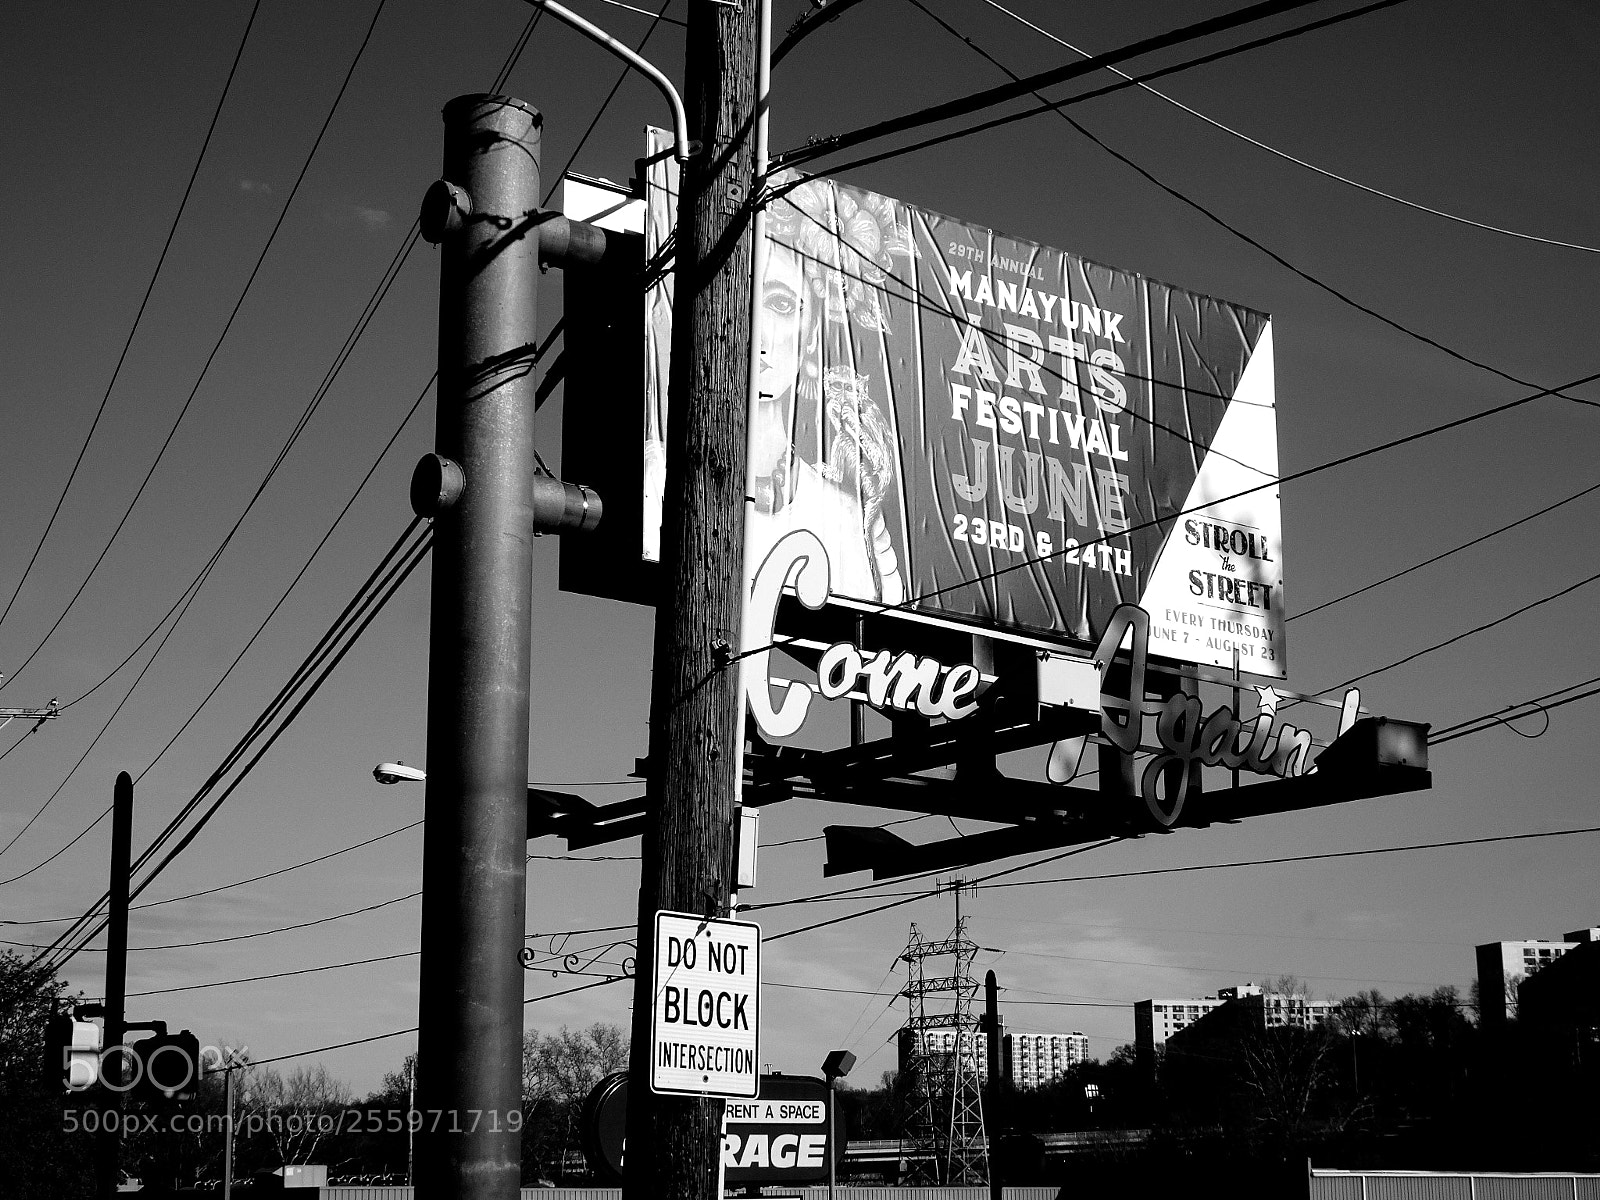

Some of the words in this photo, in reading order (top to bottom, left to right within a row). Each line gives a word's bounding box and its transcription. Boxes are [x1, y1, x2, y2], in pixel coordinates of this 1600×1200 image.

[949, 242, 985, 263] 29TH
[991, 253, 1045, 281] ANNUAL
[949, 265, 1126, 343] MANAYUNK
[951, 313, 1127, 413] ARTS
[951, 383, 1129, 461] FESTIVAL
[952, 438, 1131, 534] JUNE
[953, 514, 1025, 552] 23RD
[1037, 531, 1053, 562] &
[1066, 538, 1132, 576] 24TH
[1185, 519, 1274, 562] STROLL
[1219, 554, 1236, 572] the
[1188, 569, 1273, 610] STREET
[746, 528, 981, 737] Come
[1165, 608, 1204, 627] EVERY
[1210, 617, 1274, 641] THURSDAY
[1183, 631, 1190, 643] 7
[1261, 646, 1275, 661] 23
[668, 936, 697, 969] DO
[709, 941, 749, 975] NOT
[664, 985, 749, 1030] BLOCK
[658, 1041, 753, 1074] INTERSECTION
[726, 1104, 760, 1118] RENT
[765, 1104, 774, 1118] A
[779, 1104, 820, 1118] SPACE
[724, 1133, 827, 1168] RAGE
